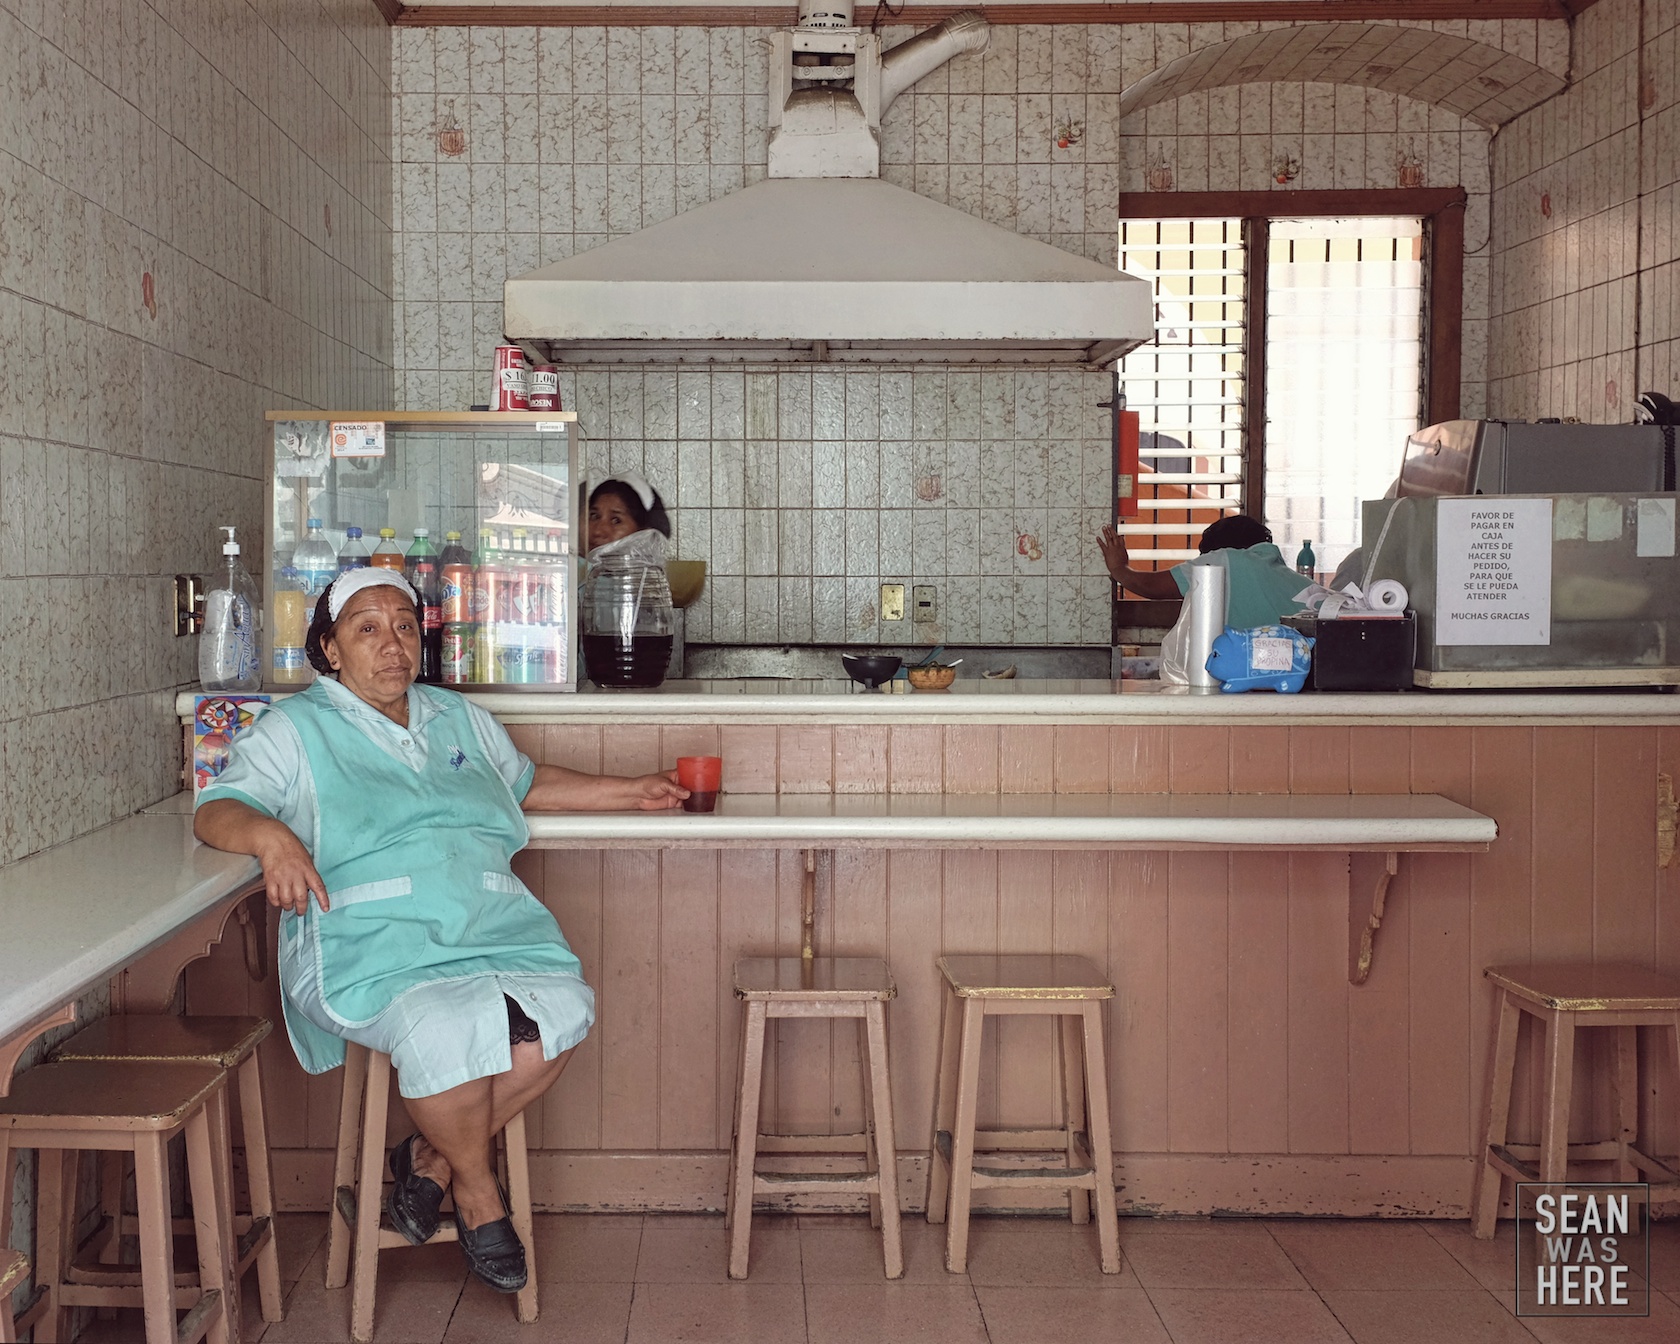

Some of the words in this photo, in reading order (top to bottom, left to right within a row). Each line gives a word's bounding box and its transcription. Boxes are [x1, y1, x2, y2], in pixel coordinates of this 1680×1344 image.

[1481, 532, 1503, 540] CAJA
[1473, 563, 1510, 571] PEDIDO,
[1495, 573, 1513, 581] QUE
[1451, 612, 1488, 620] MUCHAS
[1490, 612, 1530, 620] GRACIAS
[1254, 639, 1291, 649] GRACIAS
[1267, 649, 1279, 657] SU
